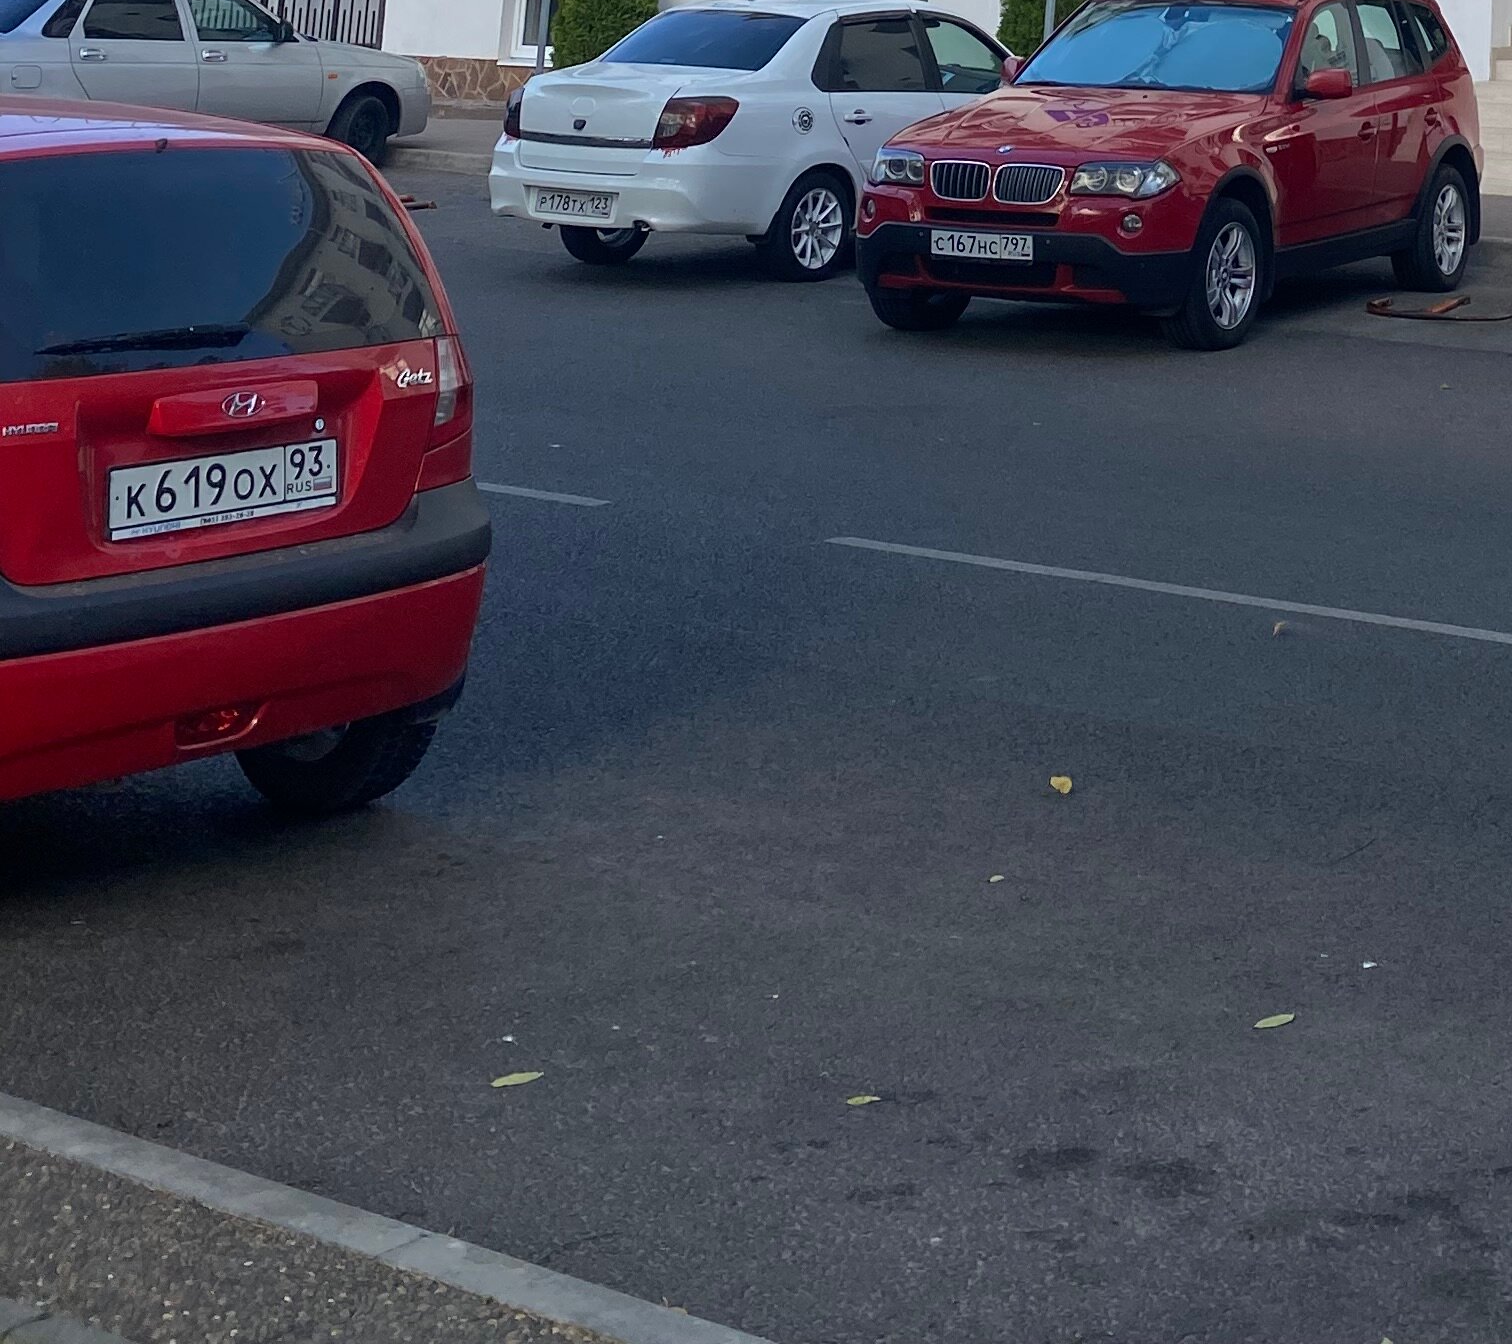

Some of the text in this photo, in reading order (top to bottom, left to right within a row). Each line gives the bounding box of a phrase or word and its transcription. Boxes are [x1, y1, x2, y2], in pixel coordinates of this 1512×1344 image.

[589, 196, 609, 210] 123
[1001, 236, 1028, 251] 797
[397, 368, 433, 388] Getz
[290, 444, 324, 480] 93
[286, 480, 312, 495] RUS
